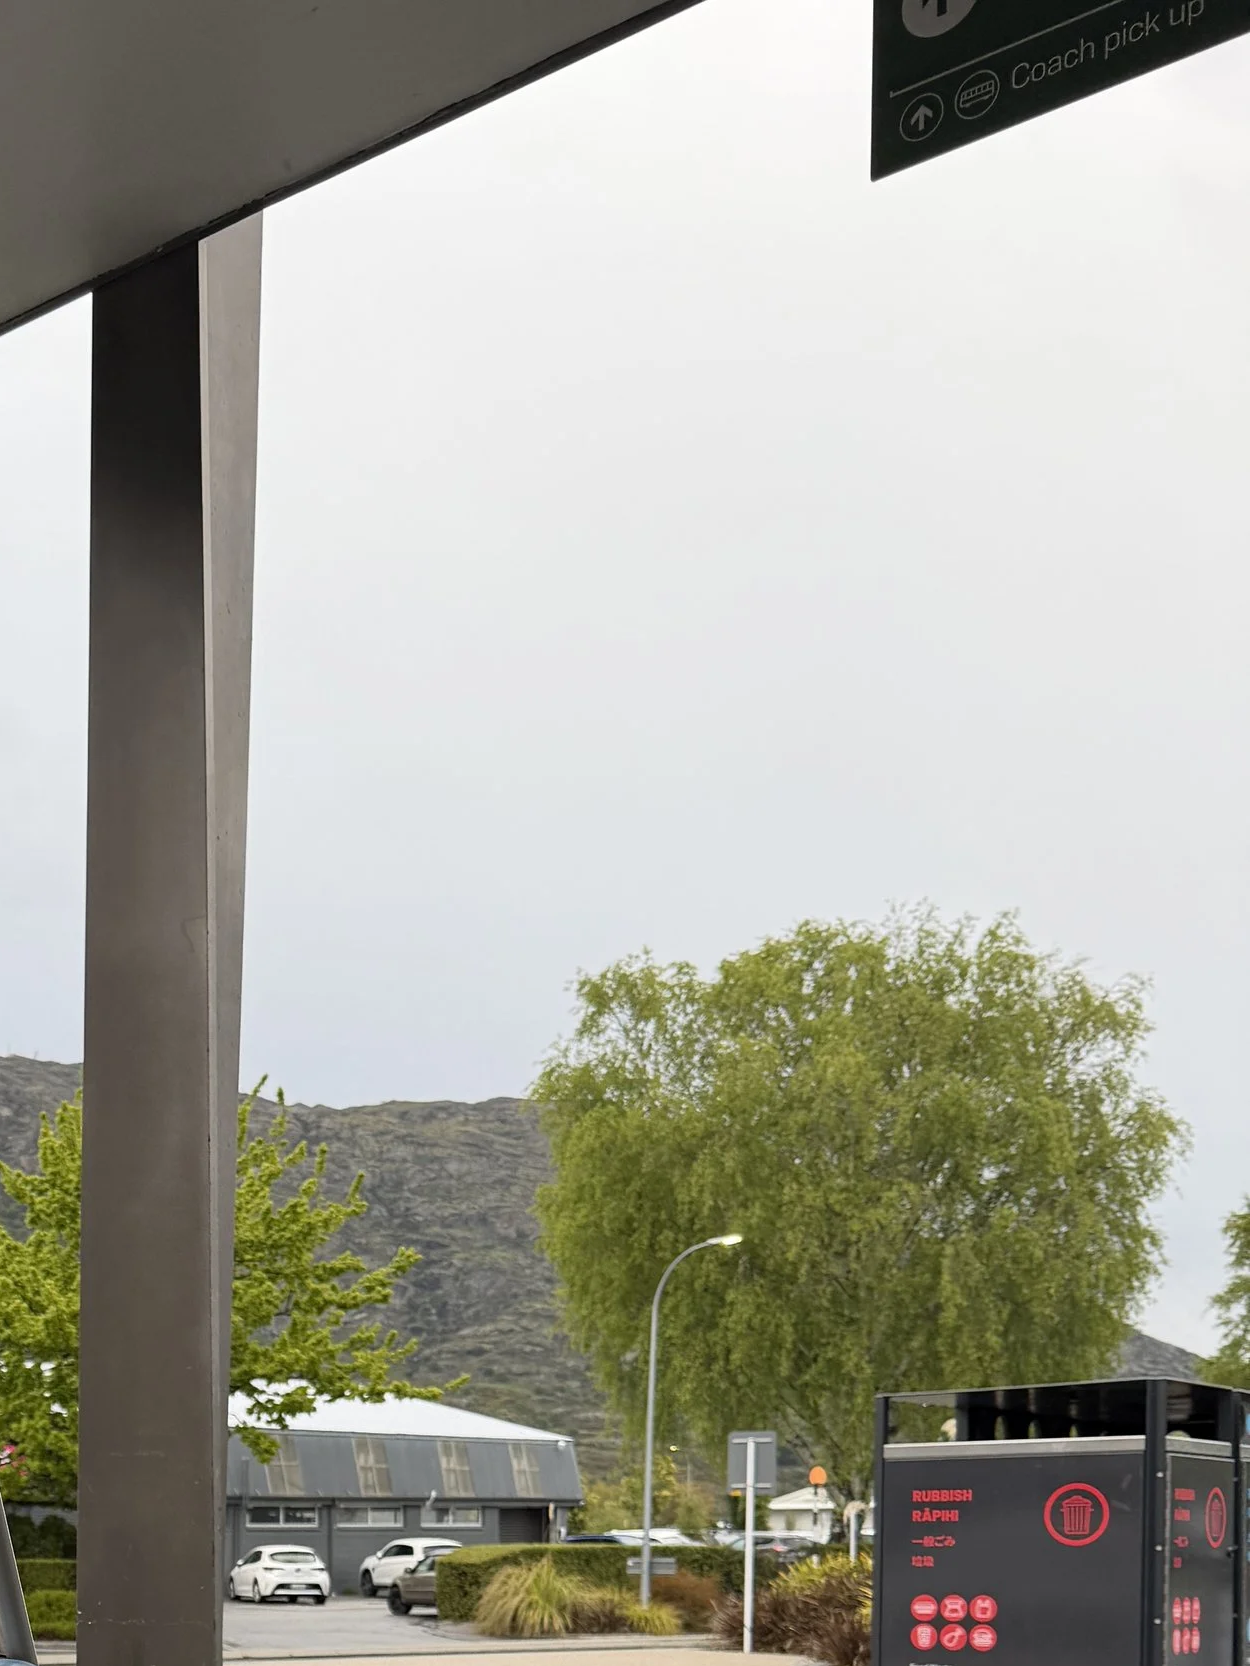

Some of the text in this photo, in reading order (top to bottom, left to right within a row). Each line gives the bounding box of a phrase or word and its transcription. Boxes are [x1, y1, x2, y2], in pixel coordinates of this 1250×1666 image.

[1011, 0, 1205, 89] Coach pick up
[912, 1489, 973, 1502] RUBBISH
